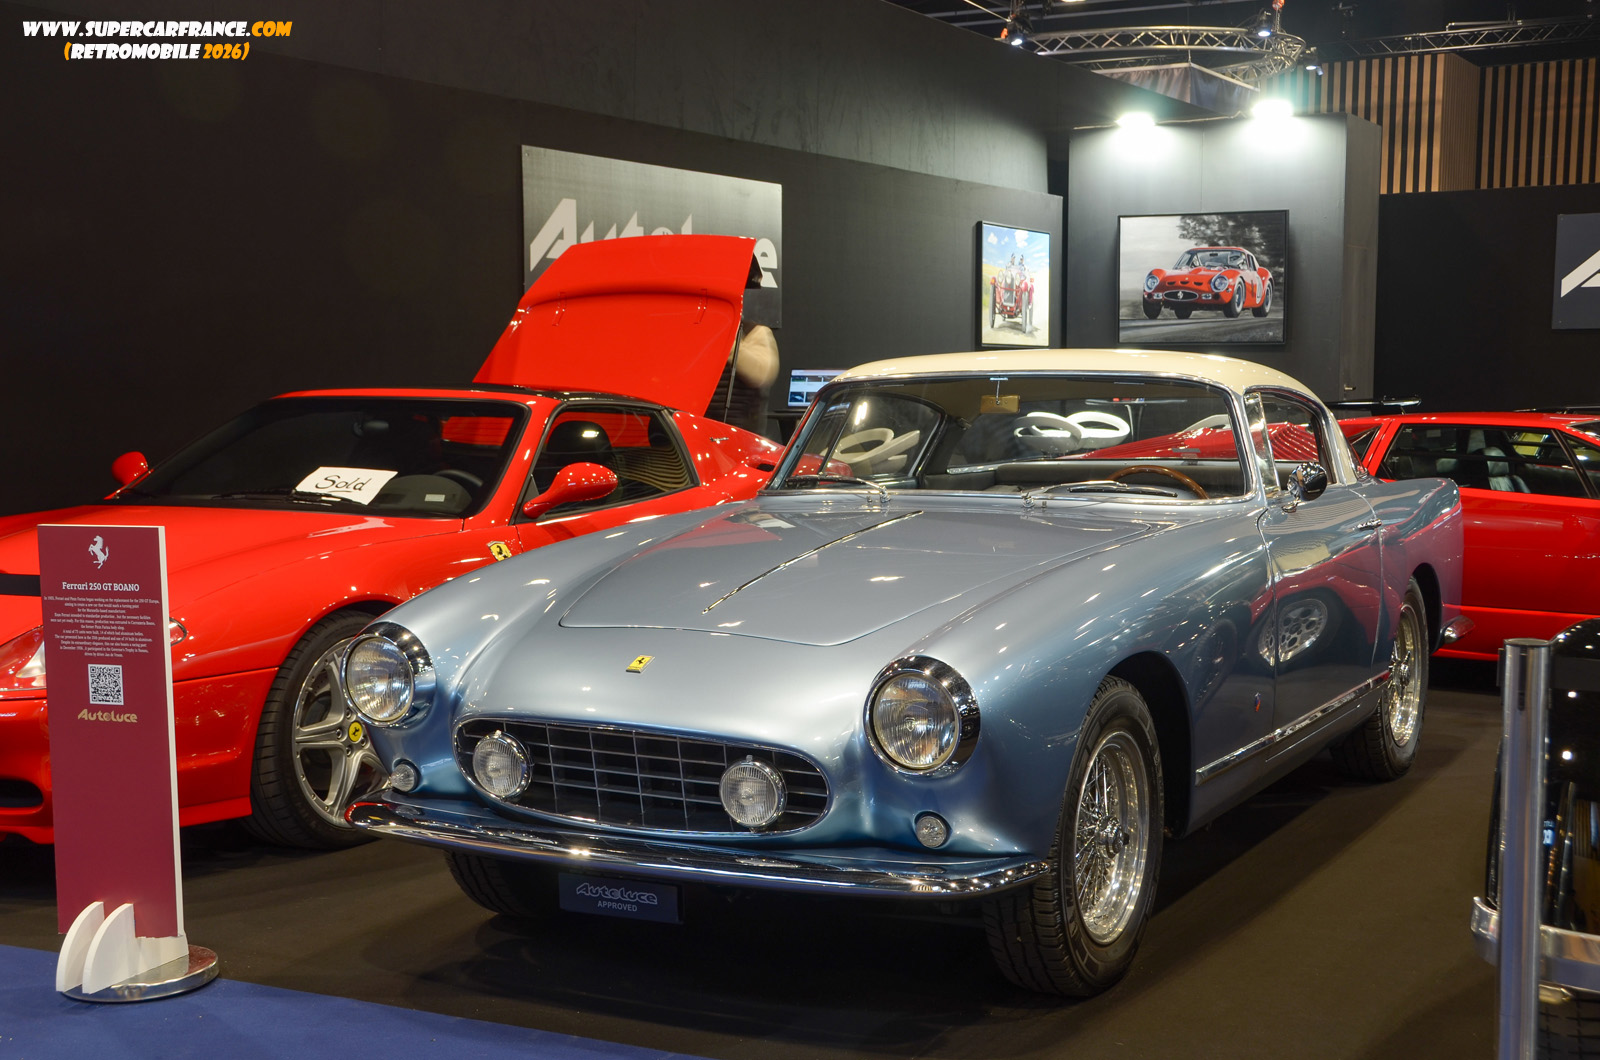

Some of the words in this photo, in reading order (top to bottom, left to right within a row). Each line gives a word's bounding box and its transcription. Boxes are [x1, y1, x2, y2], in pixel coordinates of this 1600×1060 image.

[315, 474, 372, 491] Sold
[62, 582, 88, 590] Ferrari
[89, 582, 102, 590] 250
[102, 583, 112, 591] GT
[113, 583, 140, 591] BOANO
[77, 708, 138, 723] Autoluce
[576, 882, 658, 905] Autoluce
[598, 900, 637, 912] APPROVED
